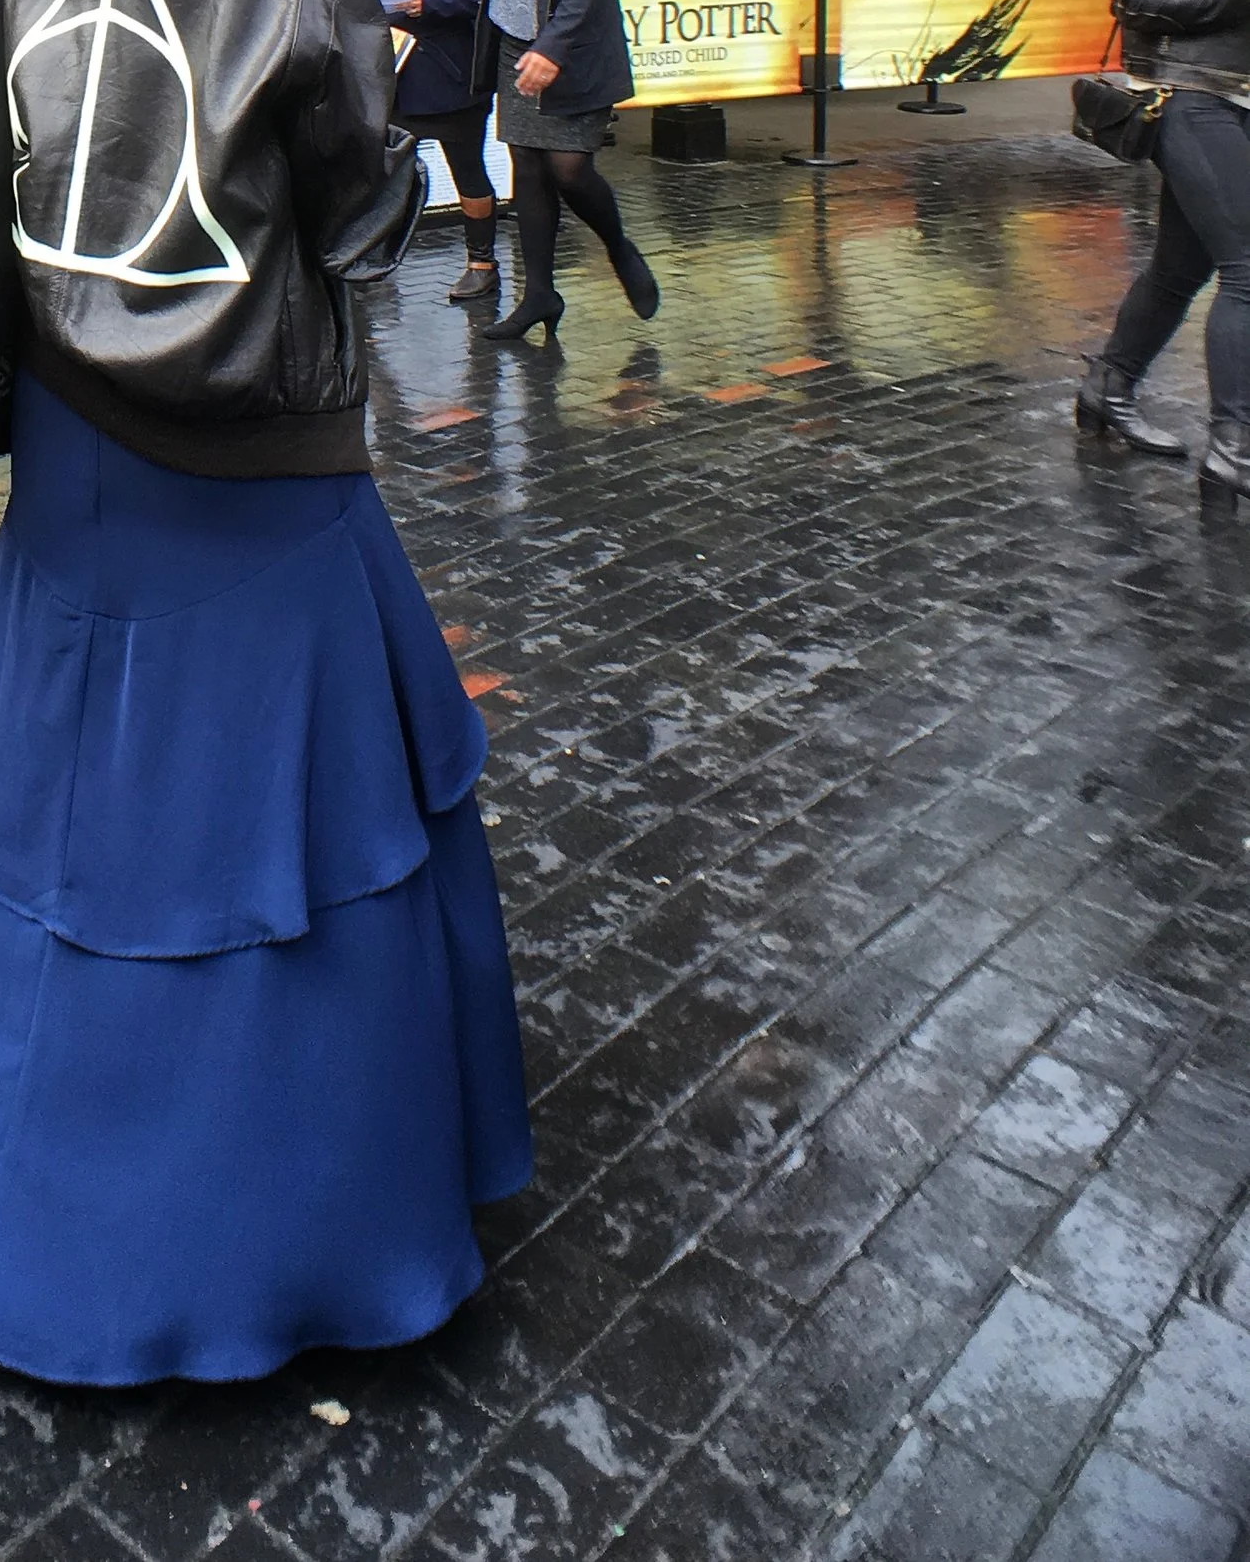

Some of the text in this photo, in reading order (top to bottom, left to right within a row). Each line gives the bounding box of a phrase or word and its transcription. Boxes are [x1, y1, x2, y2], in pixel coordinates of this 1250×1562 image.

[658, 0, 782, 44] POTTER
[630, 46, 728, 67] CURSED CHILD
